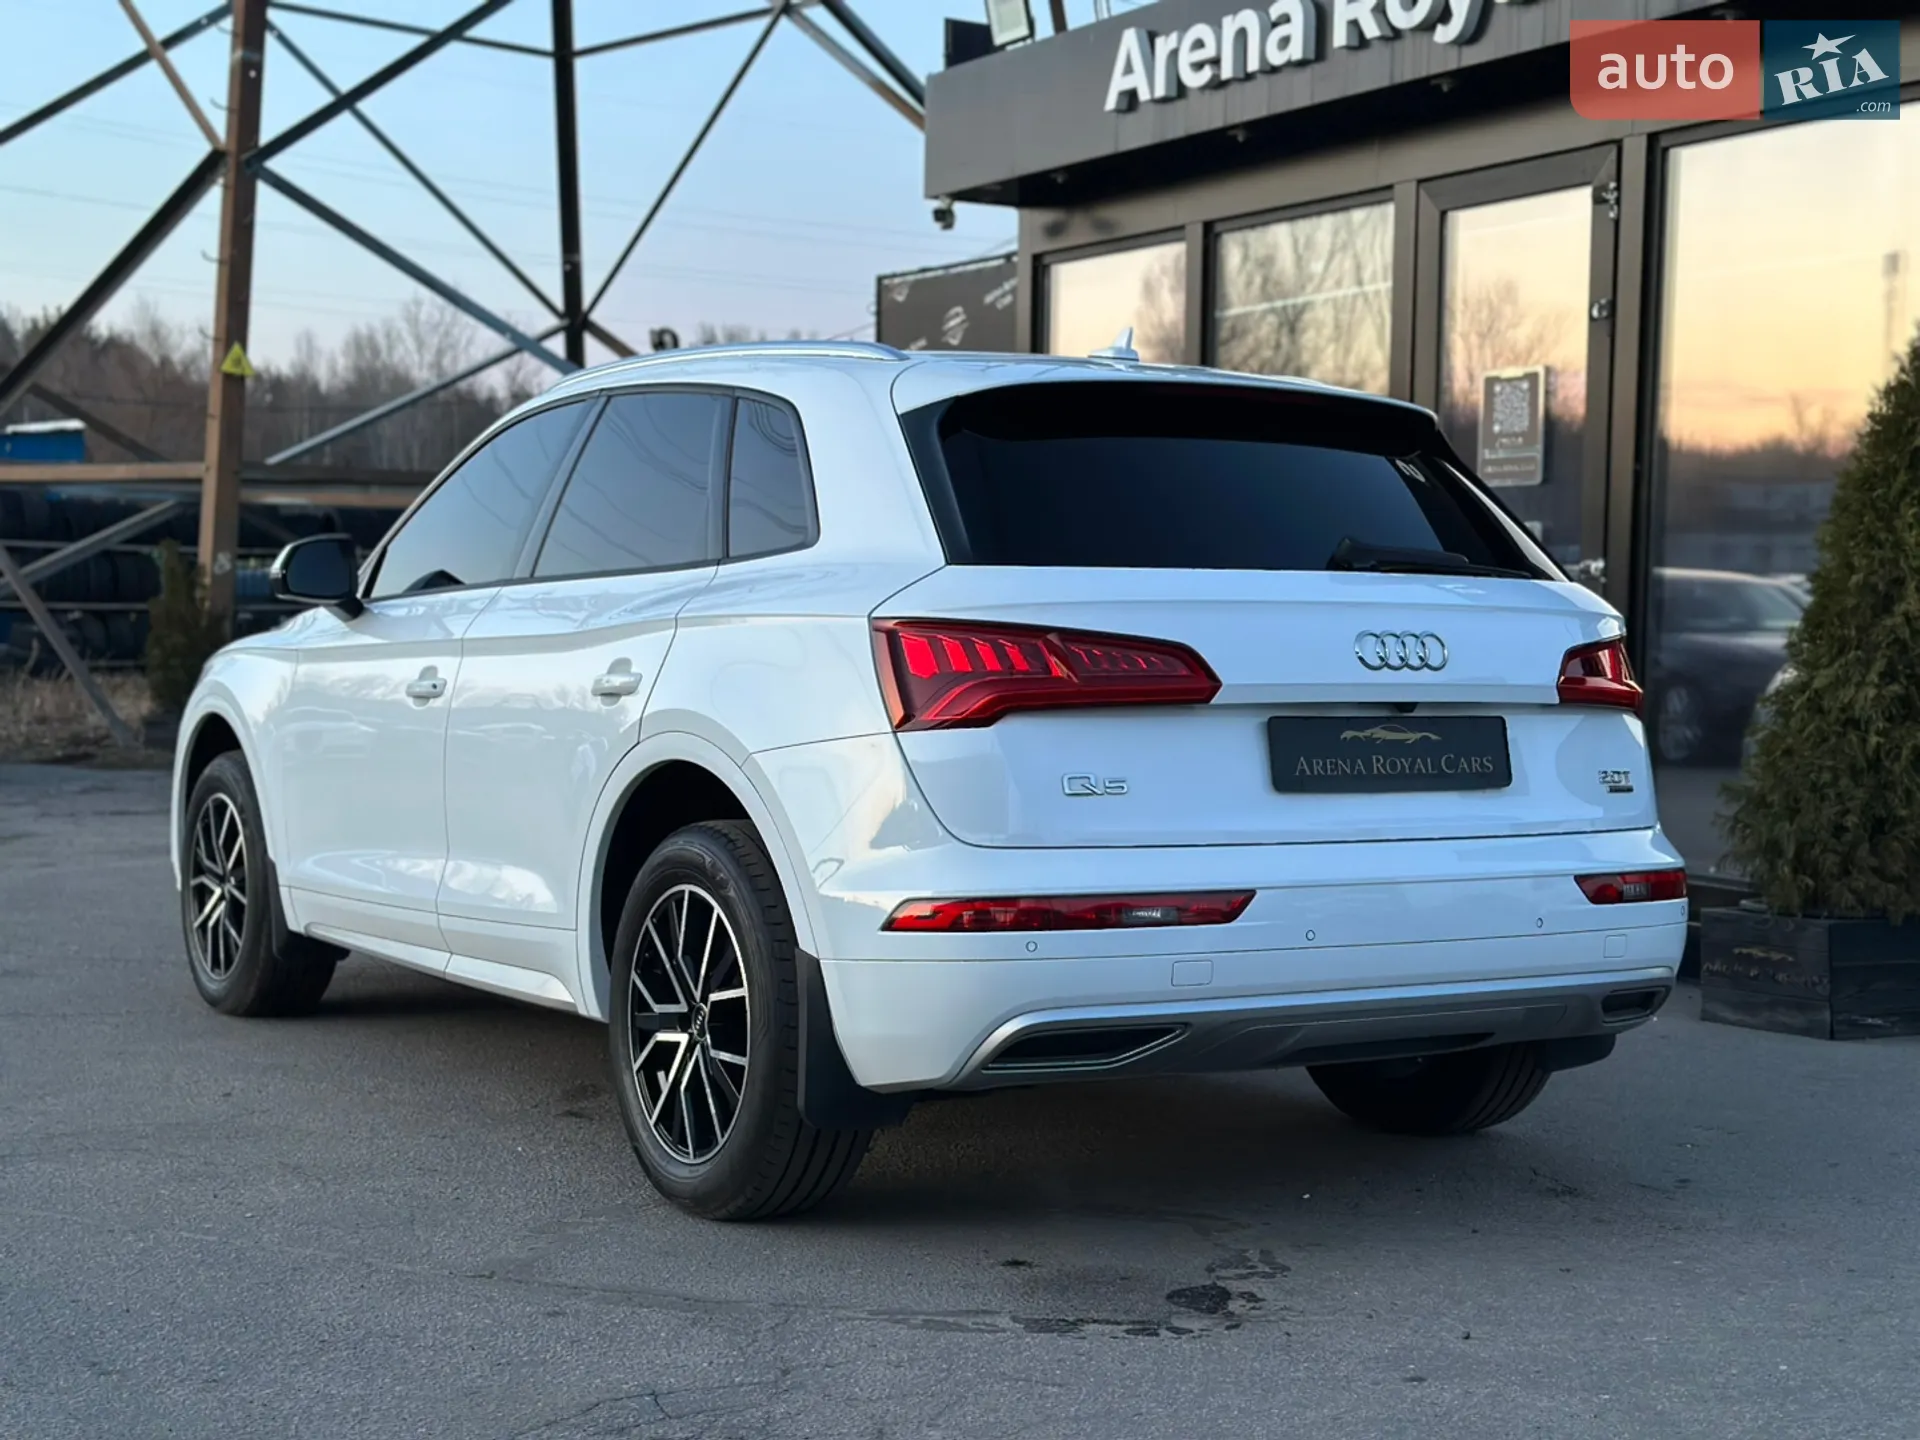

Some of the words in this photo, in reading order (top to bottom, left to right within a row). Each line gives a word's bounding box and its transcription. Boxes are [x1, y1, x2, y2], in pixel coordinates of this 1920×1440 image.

[1104, 0, 1316, 111] Arena
[1295, 756, 1366, 776] ARENA
[1372, 755, 1437, 774] ROYAL
[1441, 754, 1494, 773] CARS
[1062, 773, 1128, 797] Q5
